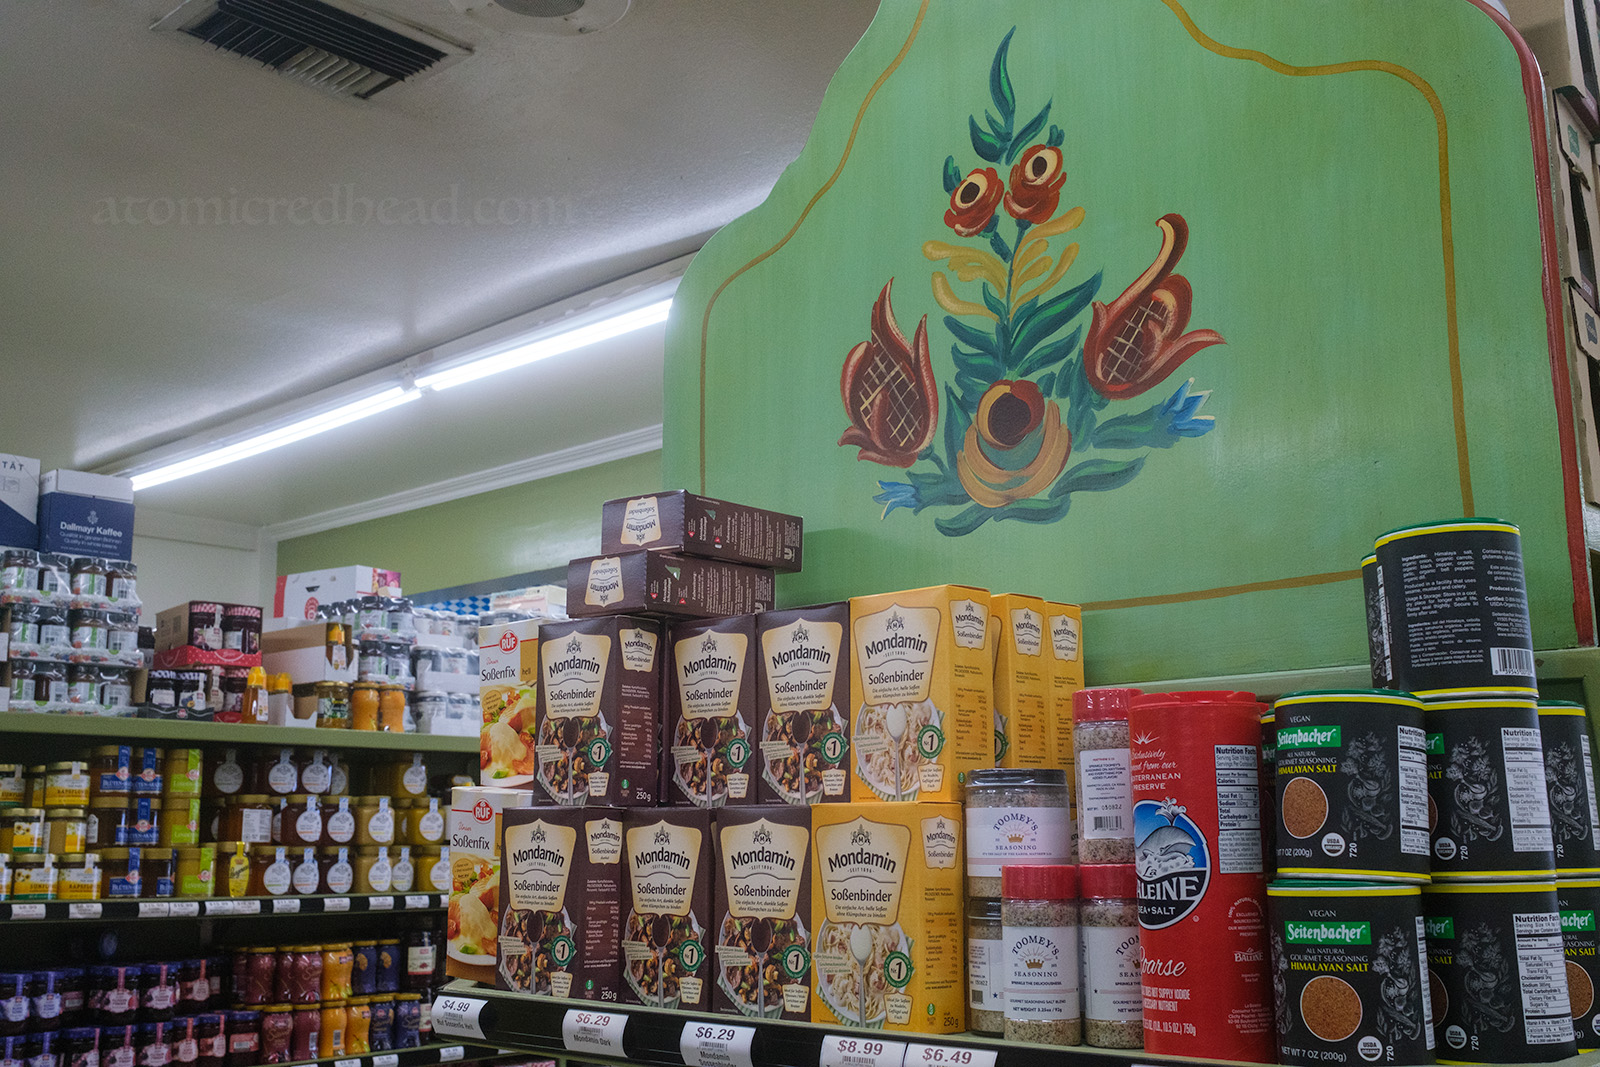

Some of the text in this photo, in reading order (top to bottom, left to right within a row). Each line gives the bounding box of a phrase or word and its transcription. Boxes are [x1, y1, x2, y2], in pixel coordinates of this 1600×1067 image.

[60, 521, 123, 538] Dallmayr Kaffee
[626, 519, 656, 533] Mondamin
[590, 581, 619, 593] Mondamin
[955, 613, 984, 626] Mondamin
[502, 637, 516, 650] RUF
[625, 640, 653, 652] Mondamin
[865, 632, 928, 659] Mondamin
[772, 641, 831, 669] Mondamin
[549, 656, 600, 679] Mondamin
[683, 654, 737, 678] Mondamin
[481, 666, 516, 682] Soßenfix
[869, 669, 924, 685] Soßenbinder
[775, 679, 827, 693] Soßenbinder
[550, 688, 596, 701] Soßenbinder
[686, 687, 733, 701] Soßenbinder
[1290, 715, 1311, 723] VEGAN
[1277, 728, 1336, 747] Seitenbacher
[1503, 729, 1532, 737] Nutrition
[832, 740, 837, 756] 1
[928, 733, 934, 751] 1
[597, 745, 602, 760] 1
[736, 746, 741, 761] 1
[1216, 747, 1243, 755] Nutrition
[1298, 757, 1337, 765] SEASONING
[1278, 764, 1337, 775] HIMALAYAN SALT
[475, 805, 491, 819] RUF
[993, 813, 1039, 832] TOOMEY'S
[452, 834, 490, 850] Soßenfix
[591, 830, 620, 842] Mondamin
[926, 830, 956, 843] Mondamin
[513, 845, 564, 867] Mondamin
[1349, 842, 1358, 858] 720
[1460, 845, 1469, 861] 720
[1556, 843, 1565, 858] 720
[635, 847, 690, 870] Mondamin
[731, 846, 796, 872] Mondamin
[828, 847, 897, 874] Mondamin
[514, 879, 560, 892] Soßenbinder
[637, 882, 687, 895] Soßenbinder
[733, 884, 791, 898] Soßenbinder
[1137, 876, 1200, 901] ALEINE
[831, 888, 893, 902] Soßenbinder
[1308, 909, 1337, 918] VEGAN
[1515, 914, 1548, 923] Nutrition
[1287, 923, 1366, 942] Seitenbacher
[560, 943, 566, 959] 1
[1011, 935, 1060, 956] TOOMEY'S
[1579, 947, 1596, 956] SALT
[689, 947, 695, 964] 1
[794, 953, 800, 970] 1
[1290, 954, 1368, 963] GOURMET SEASONING
[1433, 955, 1453, 965] SALT
[896, 961, 903, 980] 1
[1290, 962, 1369, 972] HIMALAYAN SALT
[442, 999, 471, 1013] $4.99
[575, 1012, 611, 1027] $6.29
[695, 1026, 736, 1041] $6.29
[837, 1039, 883, 1056] $8.99
[1471, 1035, 1480, 1051] 720
[922, 1047, 973, 1065] $6.49
[1302, 1048, 1306, 1057] 7
[1308, 1049, 1319, 1059] OZ
[1320, 1050, 1347, 1063] (200g)
[1386, 1045, 1395, 1062] 720
